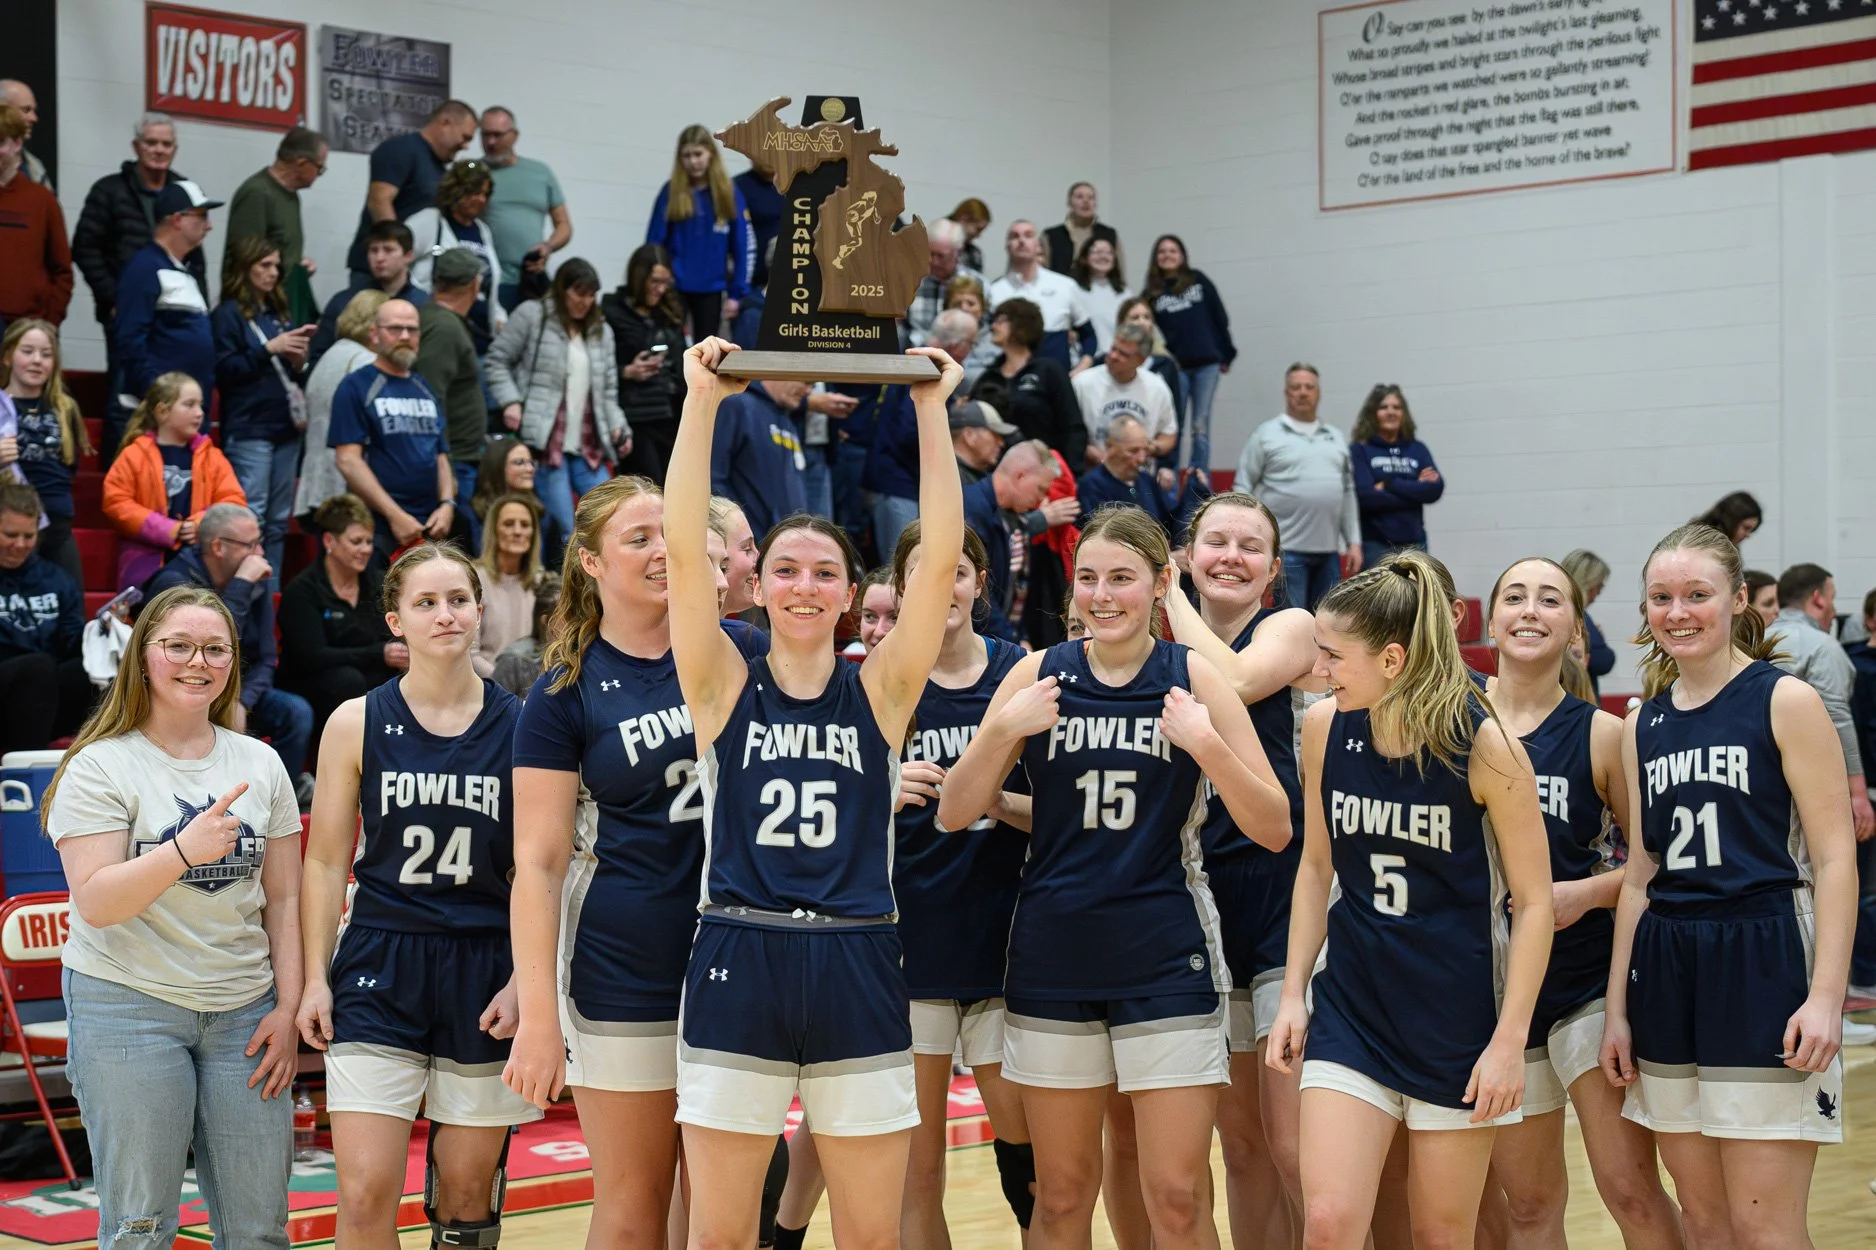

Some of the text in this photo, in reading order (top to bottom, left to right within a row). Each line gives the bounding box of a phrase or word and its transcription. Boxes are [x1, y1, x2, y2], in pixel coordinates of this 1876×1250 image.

[157, 25, 297, 112] VISITORS
[791, 198, 811, 315] CHAMPION
[850, 284, 884, 297] 2025
[778, 323, 880, 339] Girls Basketball
[808, 340, 851, 349] DIVISION 4
[374, 397, 438, 418] FOWLER
[617, 703, 693, 767] FOW
[742, 720, 864, 775] FOWLER
[907, 724, 979, 763] FOW
[1048, 716, 1172, 763] FOWLER
[380, 771, 500, 822] FOWLER
[1075, 769, 1137, 830] 15
[1645, 745, 1750, 807] FOWLER
[755, 778, 837, 848] 25
[1331, 789, 1452, 852] FOWLER
[1666, 803, 1721, 871] 21
[398, 825, 473, 885] 24
[1369, 853, 1408, 917] 5
